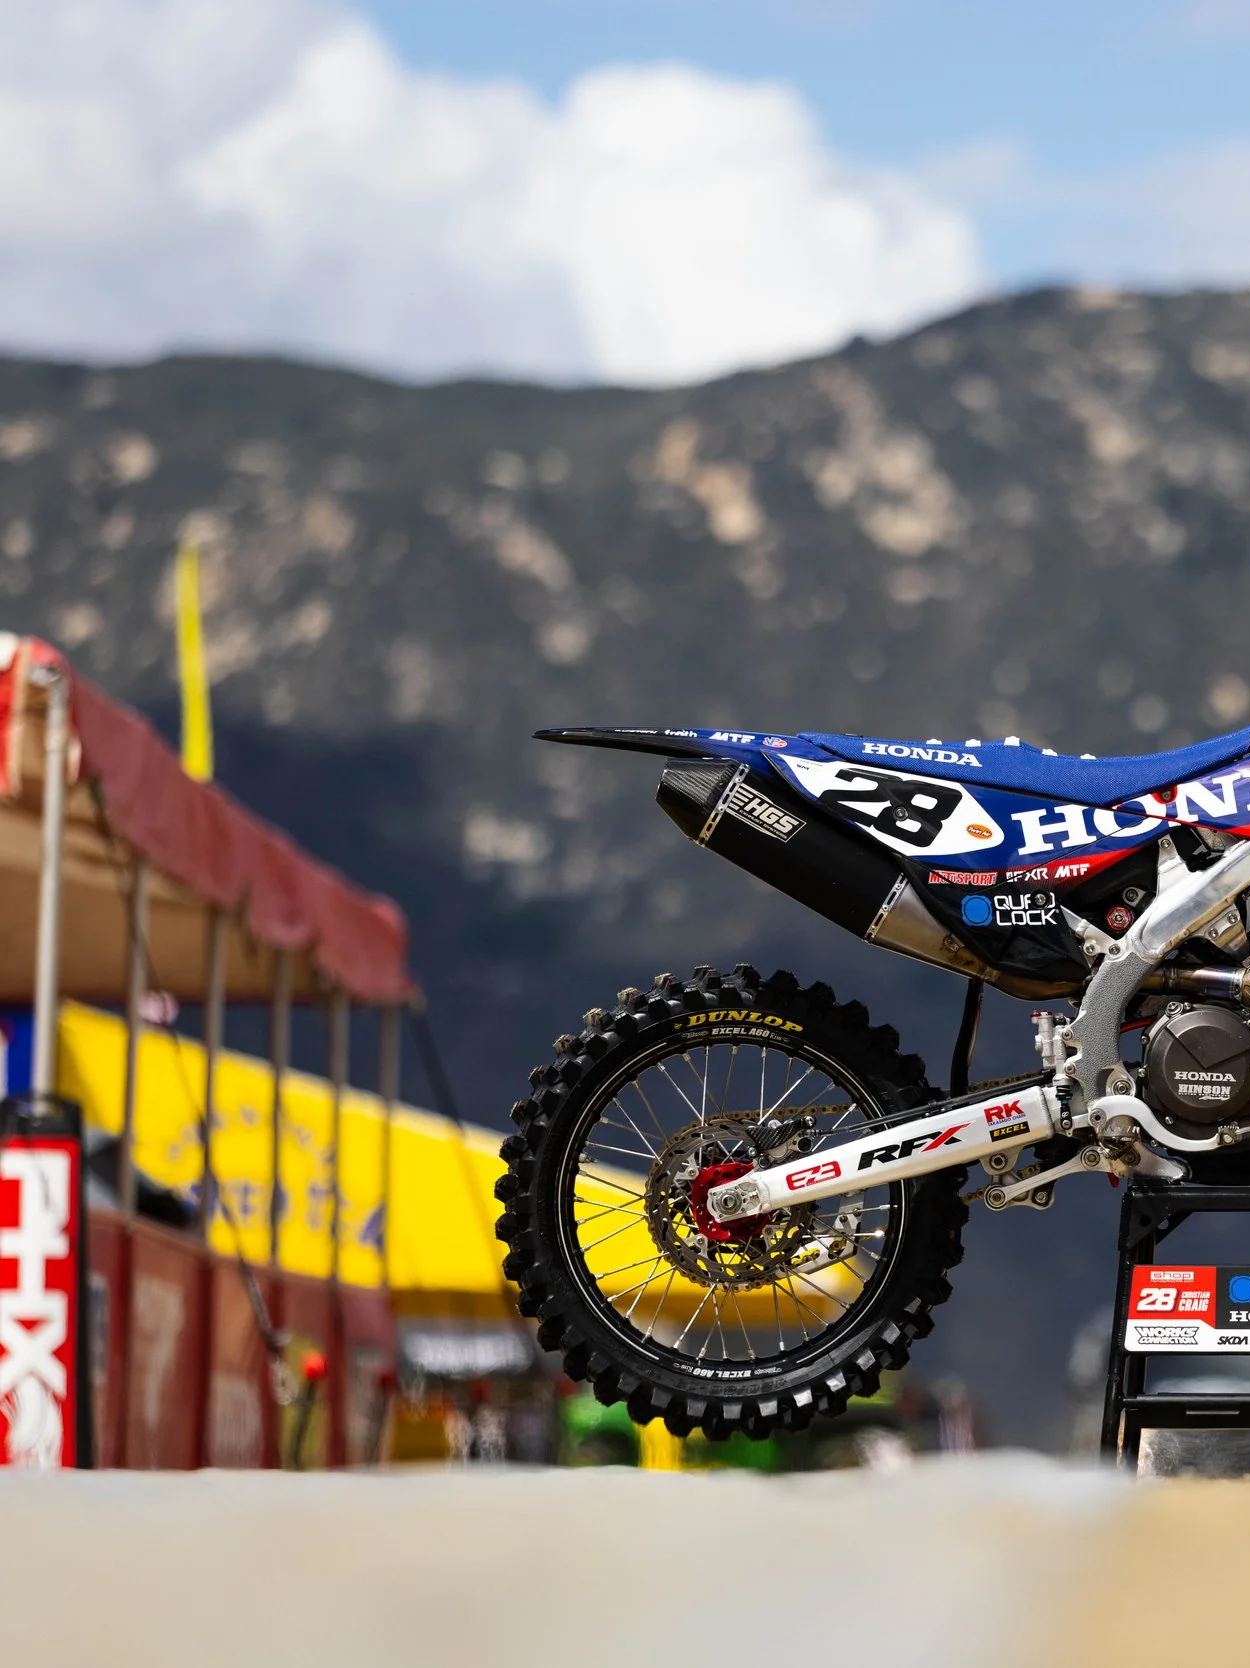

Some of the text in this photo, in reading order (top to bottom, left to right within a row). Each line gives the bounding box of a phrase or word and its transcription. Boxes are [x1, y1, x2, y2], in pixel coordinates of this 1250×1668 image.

[708, 731, 755, 744] MTF
[862, 742, 982, 767] HONDA
[746, 793, 800, 833] HGS
[818, 767, 963, 848] 28
[1054, 863, 1090, 878] MTF
[996, 909, 1057, 926] LOCK
[687, 1010, 804, 1033] DUNLOP
[711, 1027, 747, 1036] EXCEL
[1174, 1071, 1236, 1082] HONDA
[1178, 1083, 1231, 1096] HINSON
[984, 1100, 1025, 1123] RK
[993, 1123, 1027, 1137] EXCEL
[857, 1122, 974, 1172] RFX
[1136, 1287, 1178, 1312] 28
[1181, 1290, 1211, 1299] CHRISTIAN
[1178, 1298, 1209, 1312] CRAIG
[1135, 1326, 1200, 1338] WORKS
[1138, 1335, 1199, 1346] CONNECTION
